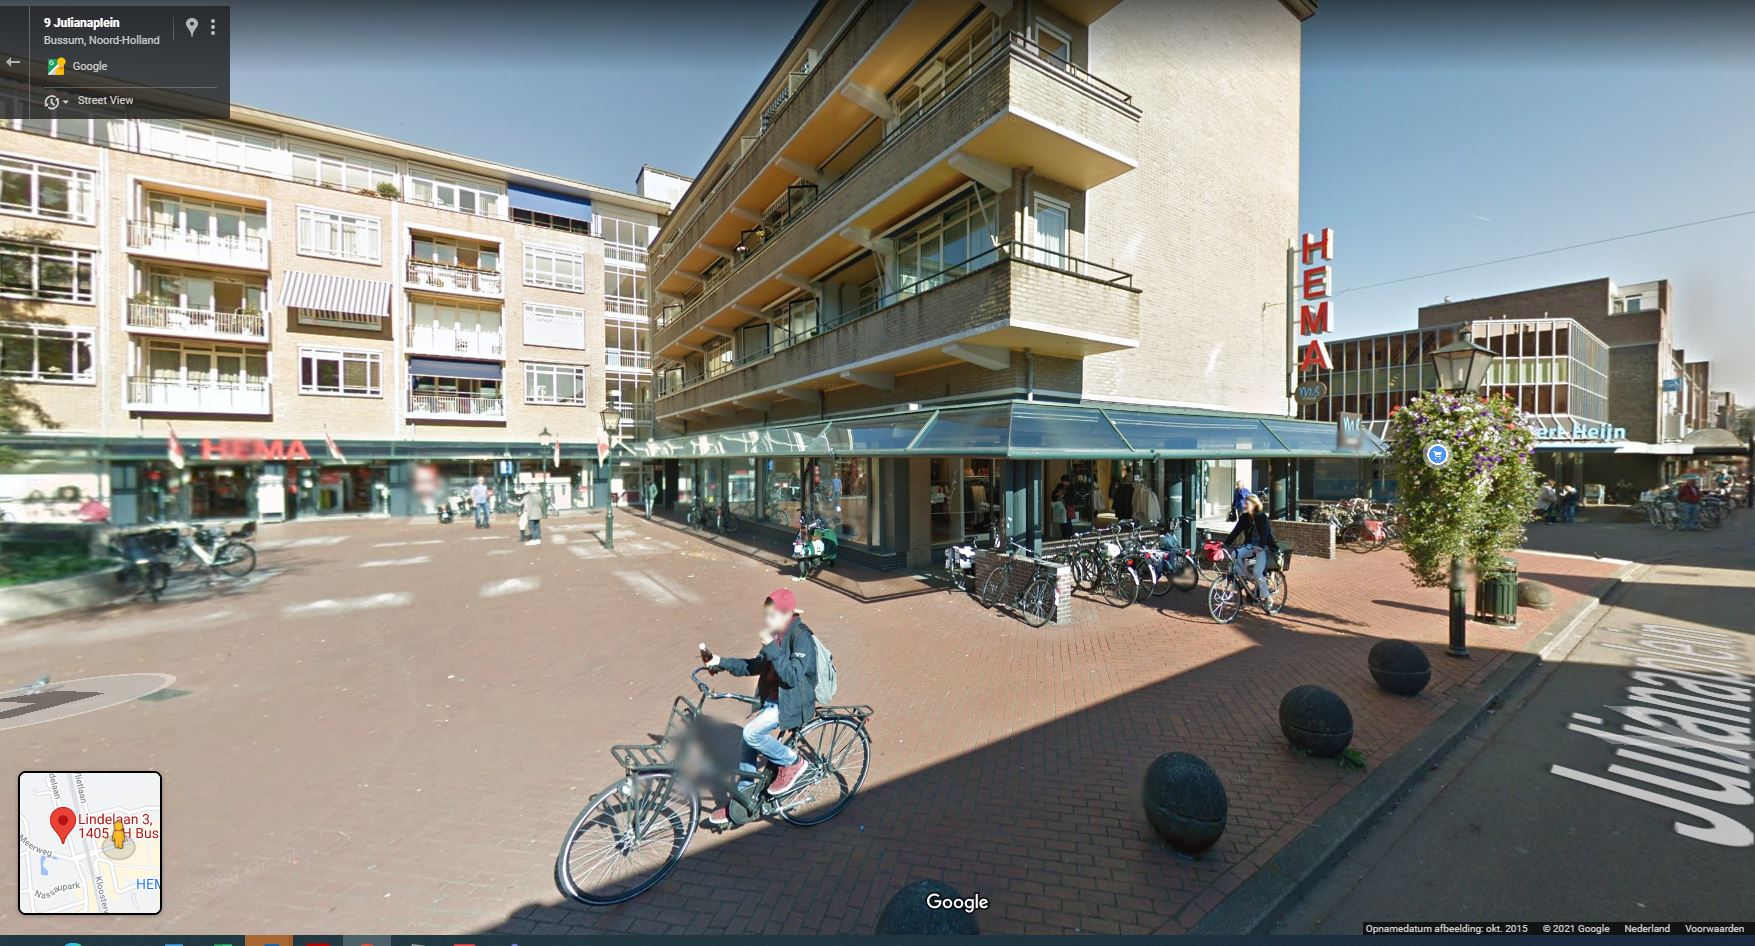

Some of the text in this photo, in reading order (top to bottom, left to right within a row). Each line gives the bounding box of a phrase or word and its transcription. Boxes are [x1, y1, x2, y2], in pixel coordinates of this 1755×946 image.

[1301, 227, 1334, 372] HEMA
[1573, 423, 1626, 442] Heijn
[200, 438, 311, 461] HEMA
